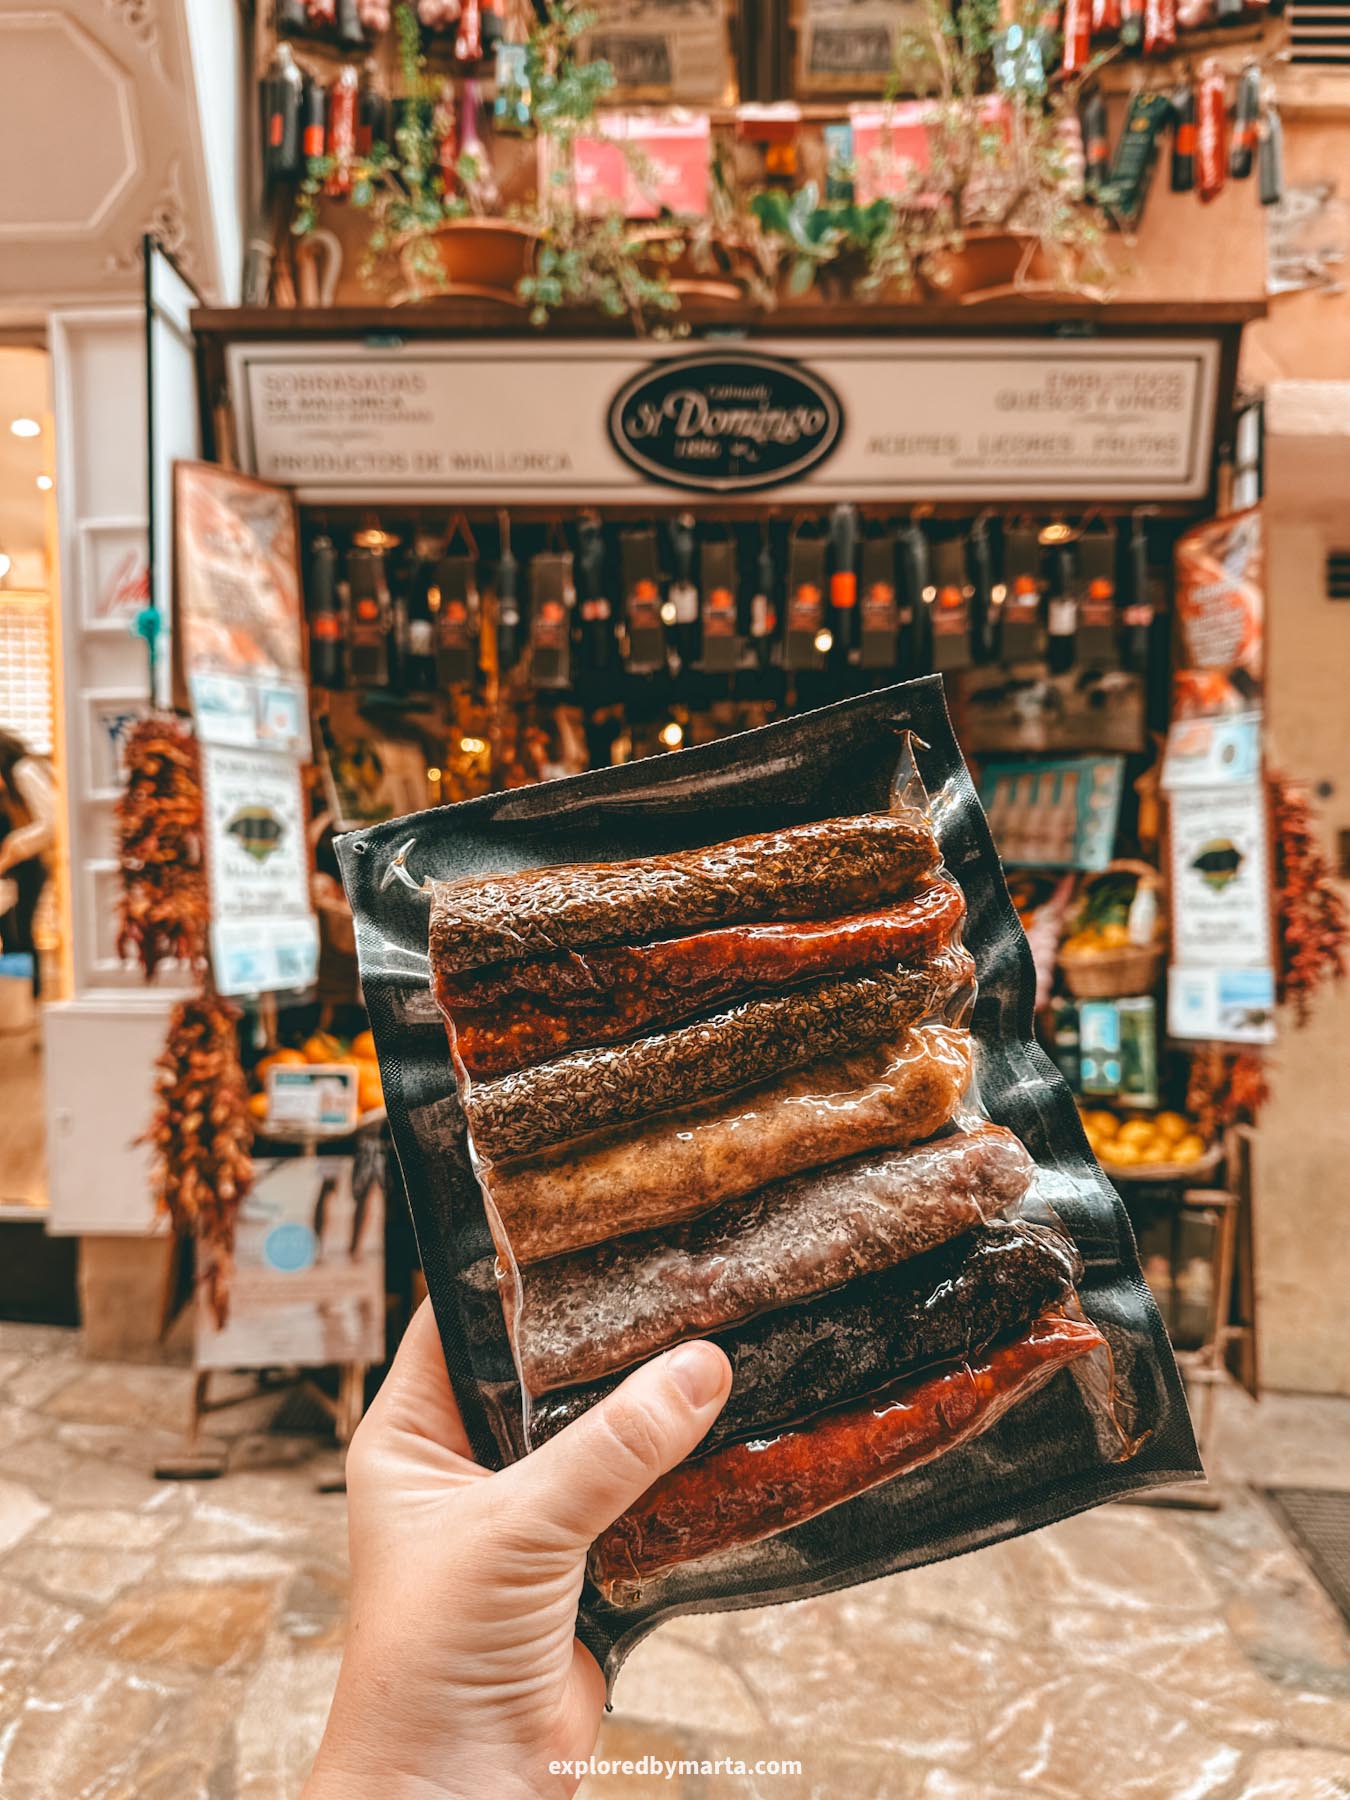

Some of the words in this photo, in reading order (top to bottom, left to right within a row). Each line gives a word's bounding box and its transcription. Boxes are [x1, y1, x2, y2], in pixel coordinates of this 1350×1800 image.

[663, 388, 826, 444] Domingo
[272, 453, 409, 472] PRODUCTOS
[413, 453, 441, 472] DE
[451, 453, 572, 472] MALLORCA
